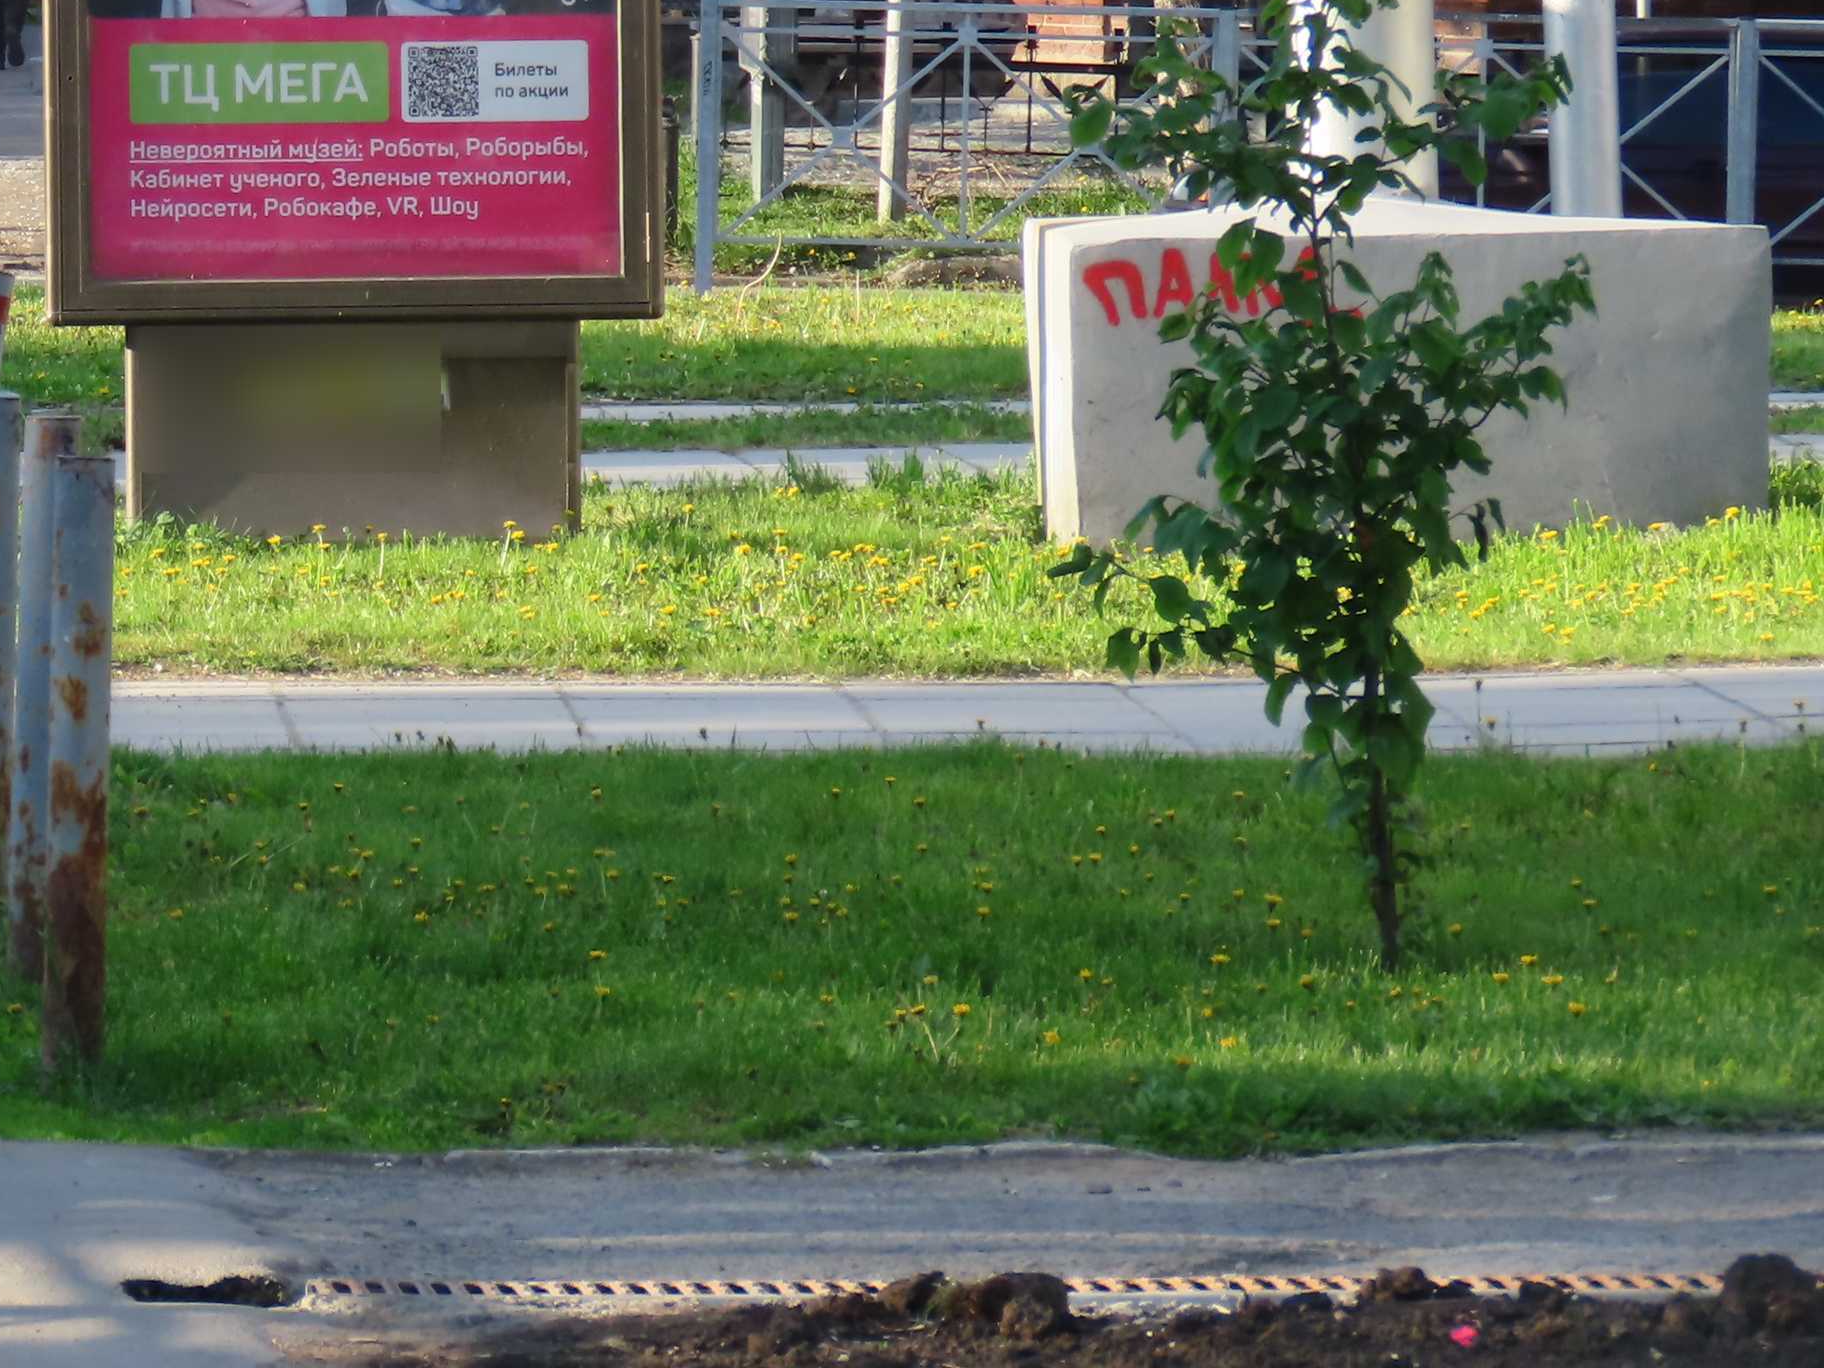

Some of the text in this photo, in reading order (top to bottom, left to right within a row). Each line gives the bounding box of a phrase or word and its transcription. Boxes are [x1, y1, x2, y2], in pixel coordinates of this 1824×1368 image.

[494, 62, 558, 78] Билеты
[149, 62, 369, 112] ТЦ МЕГА
[494, 83, 569, 101] по акции
[129, 137, 590, 163] Невероятный музей: Роботы, Роборыбы,
[130, 168, 573, 194] Кабинет ученого, Зеленые технологии,
[130, 196, 480, 221] Нейросети, Робокафе, VR, Шоу
